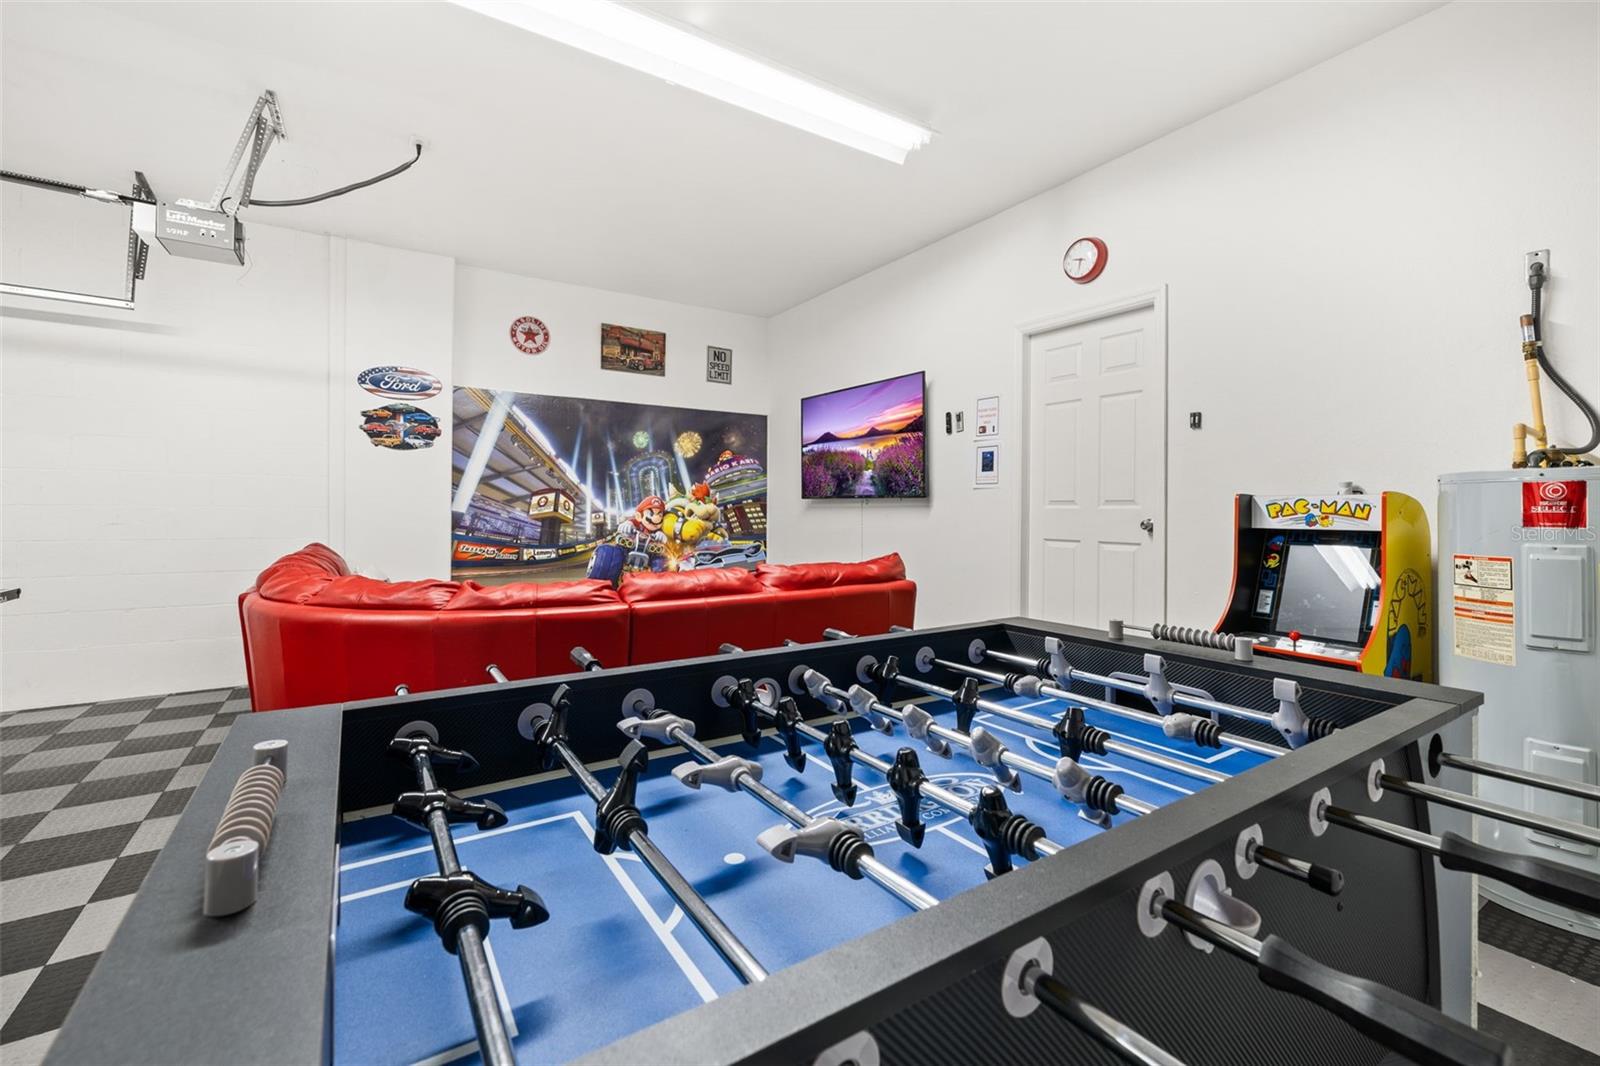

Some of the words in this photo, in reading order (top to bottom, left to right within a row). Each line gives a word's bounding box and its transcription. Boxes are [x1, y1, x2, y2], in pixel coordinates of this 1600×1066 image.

[713, 350, 727, 363] NO
[709, 361, 730, 371] SPEED
[709, 370, 729, 380] LIMIT
[380, 375, 423, 391] Ford
[705, 463, 730, 479] MARIO
[1266, 498, 1372, 521] PAC-MAN
[1530, 505, 1577, 513] SELECT
